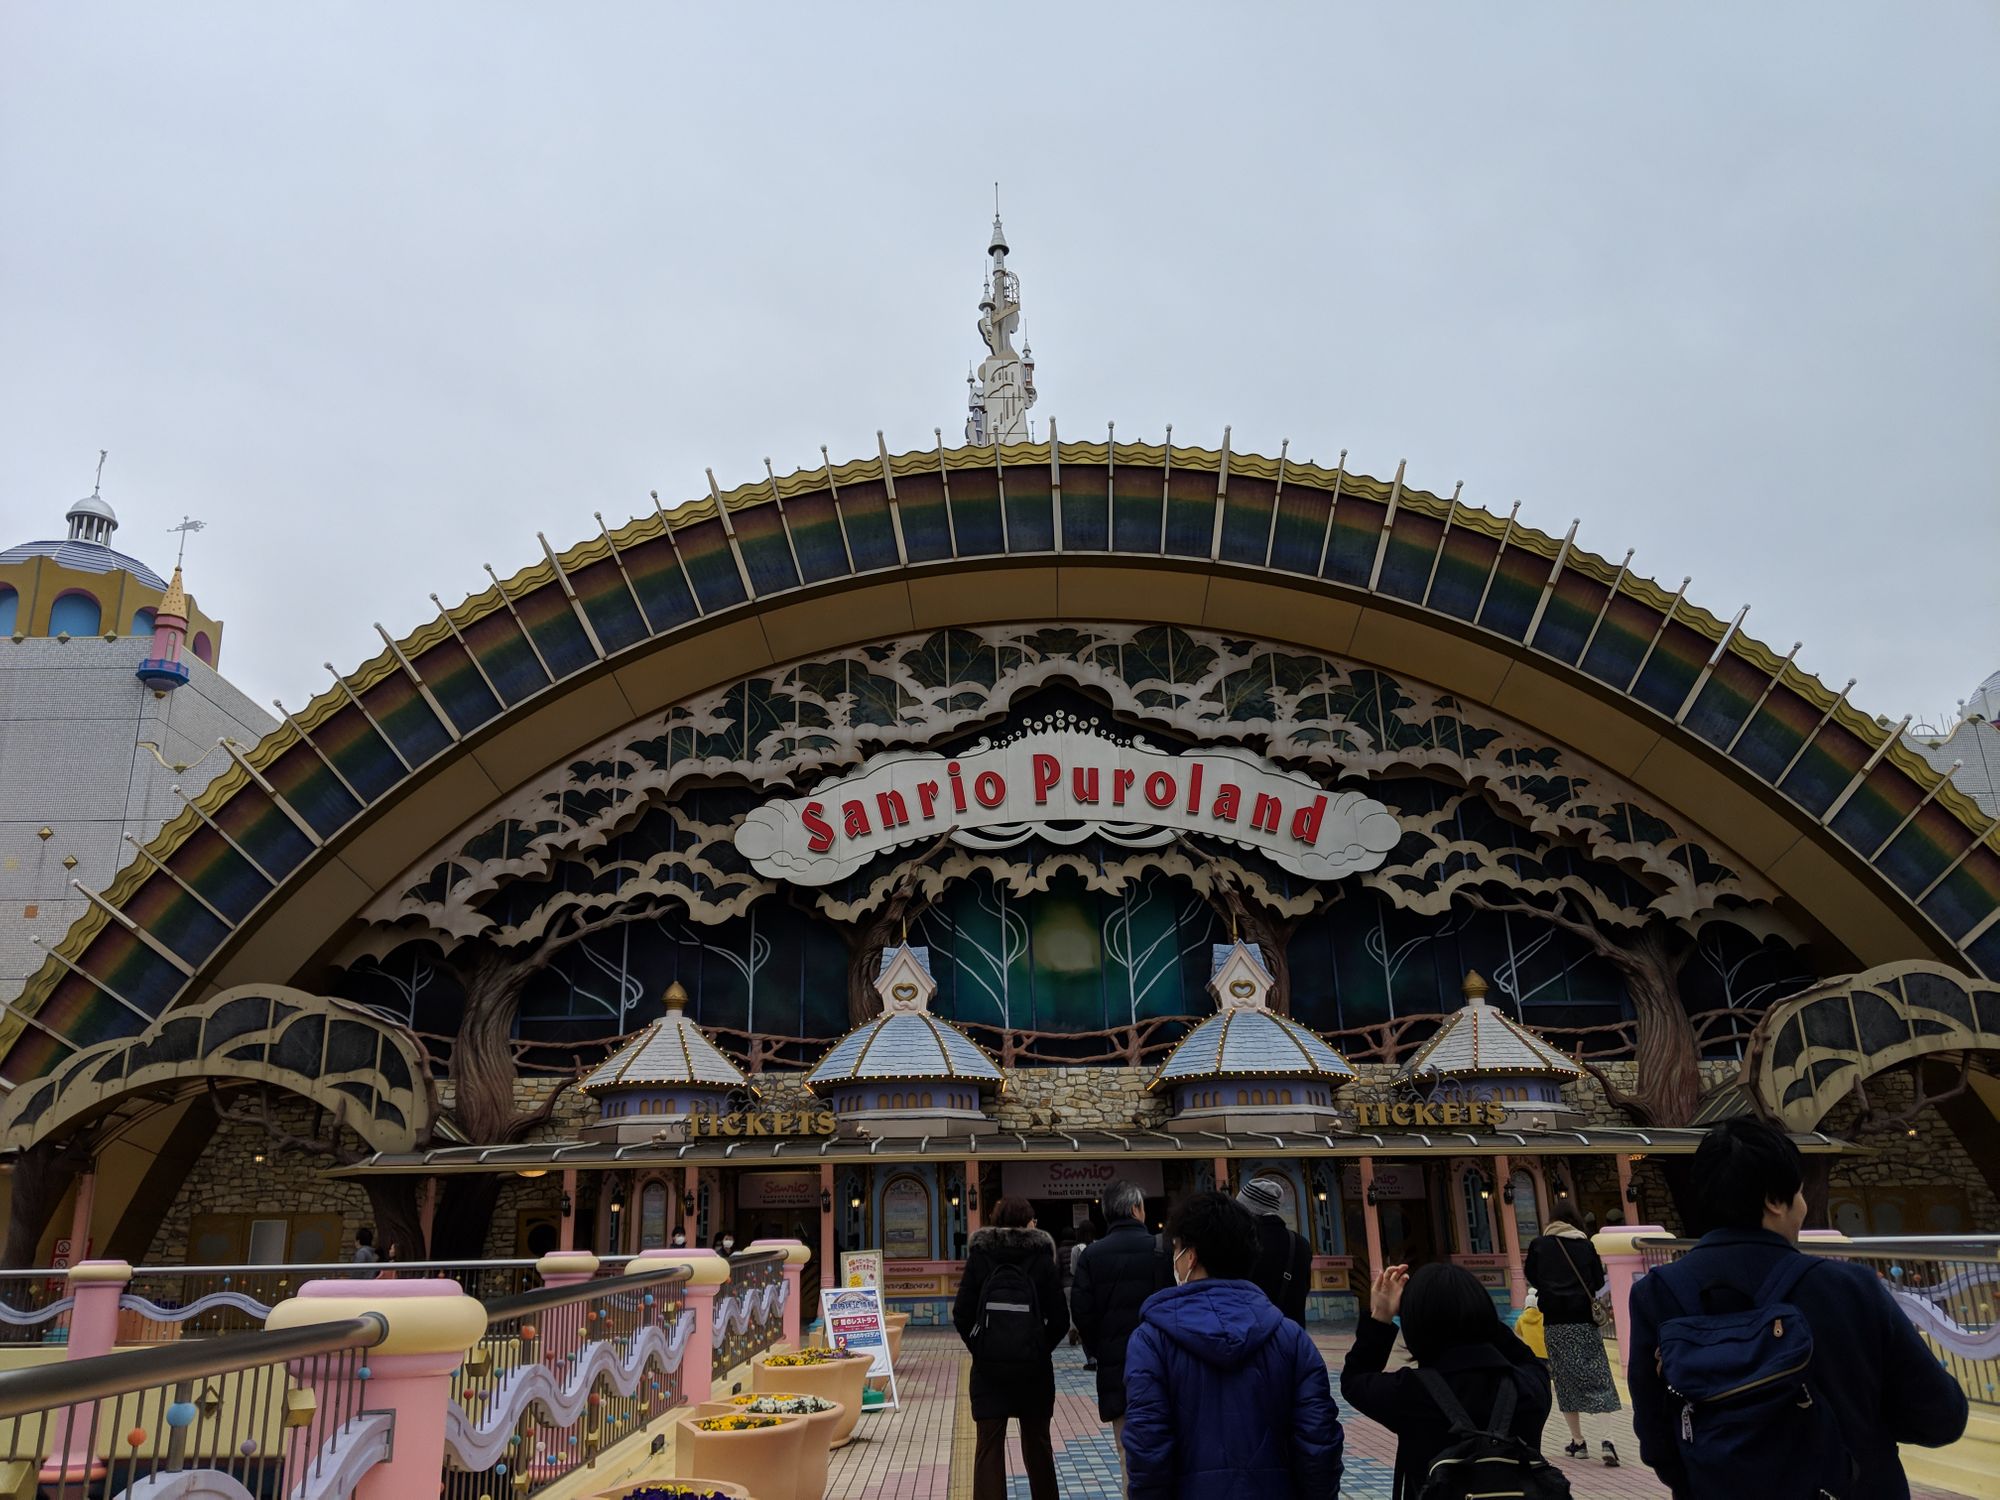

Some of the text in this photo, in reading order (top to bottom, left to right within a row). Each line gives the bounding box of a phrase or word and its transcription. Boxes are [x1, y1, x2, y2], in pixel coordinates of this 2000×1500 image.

[801, 752, 1328, 852] Sanrio Puroland
[687, 1111, 836, 1137] TICKETS
[1354, 1101, 1507, 1126] TICKETS
[1049, 1162, 1115, 1180] Sanrio
[764, 1181, 809, 1194] Sanrio
